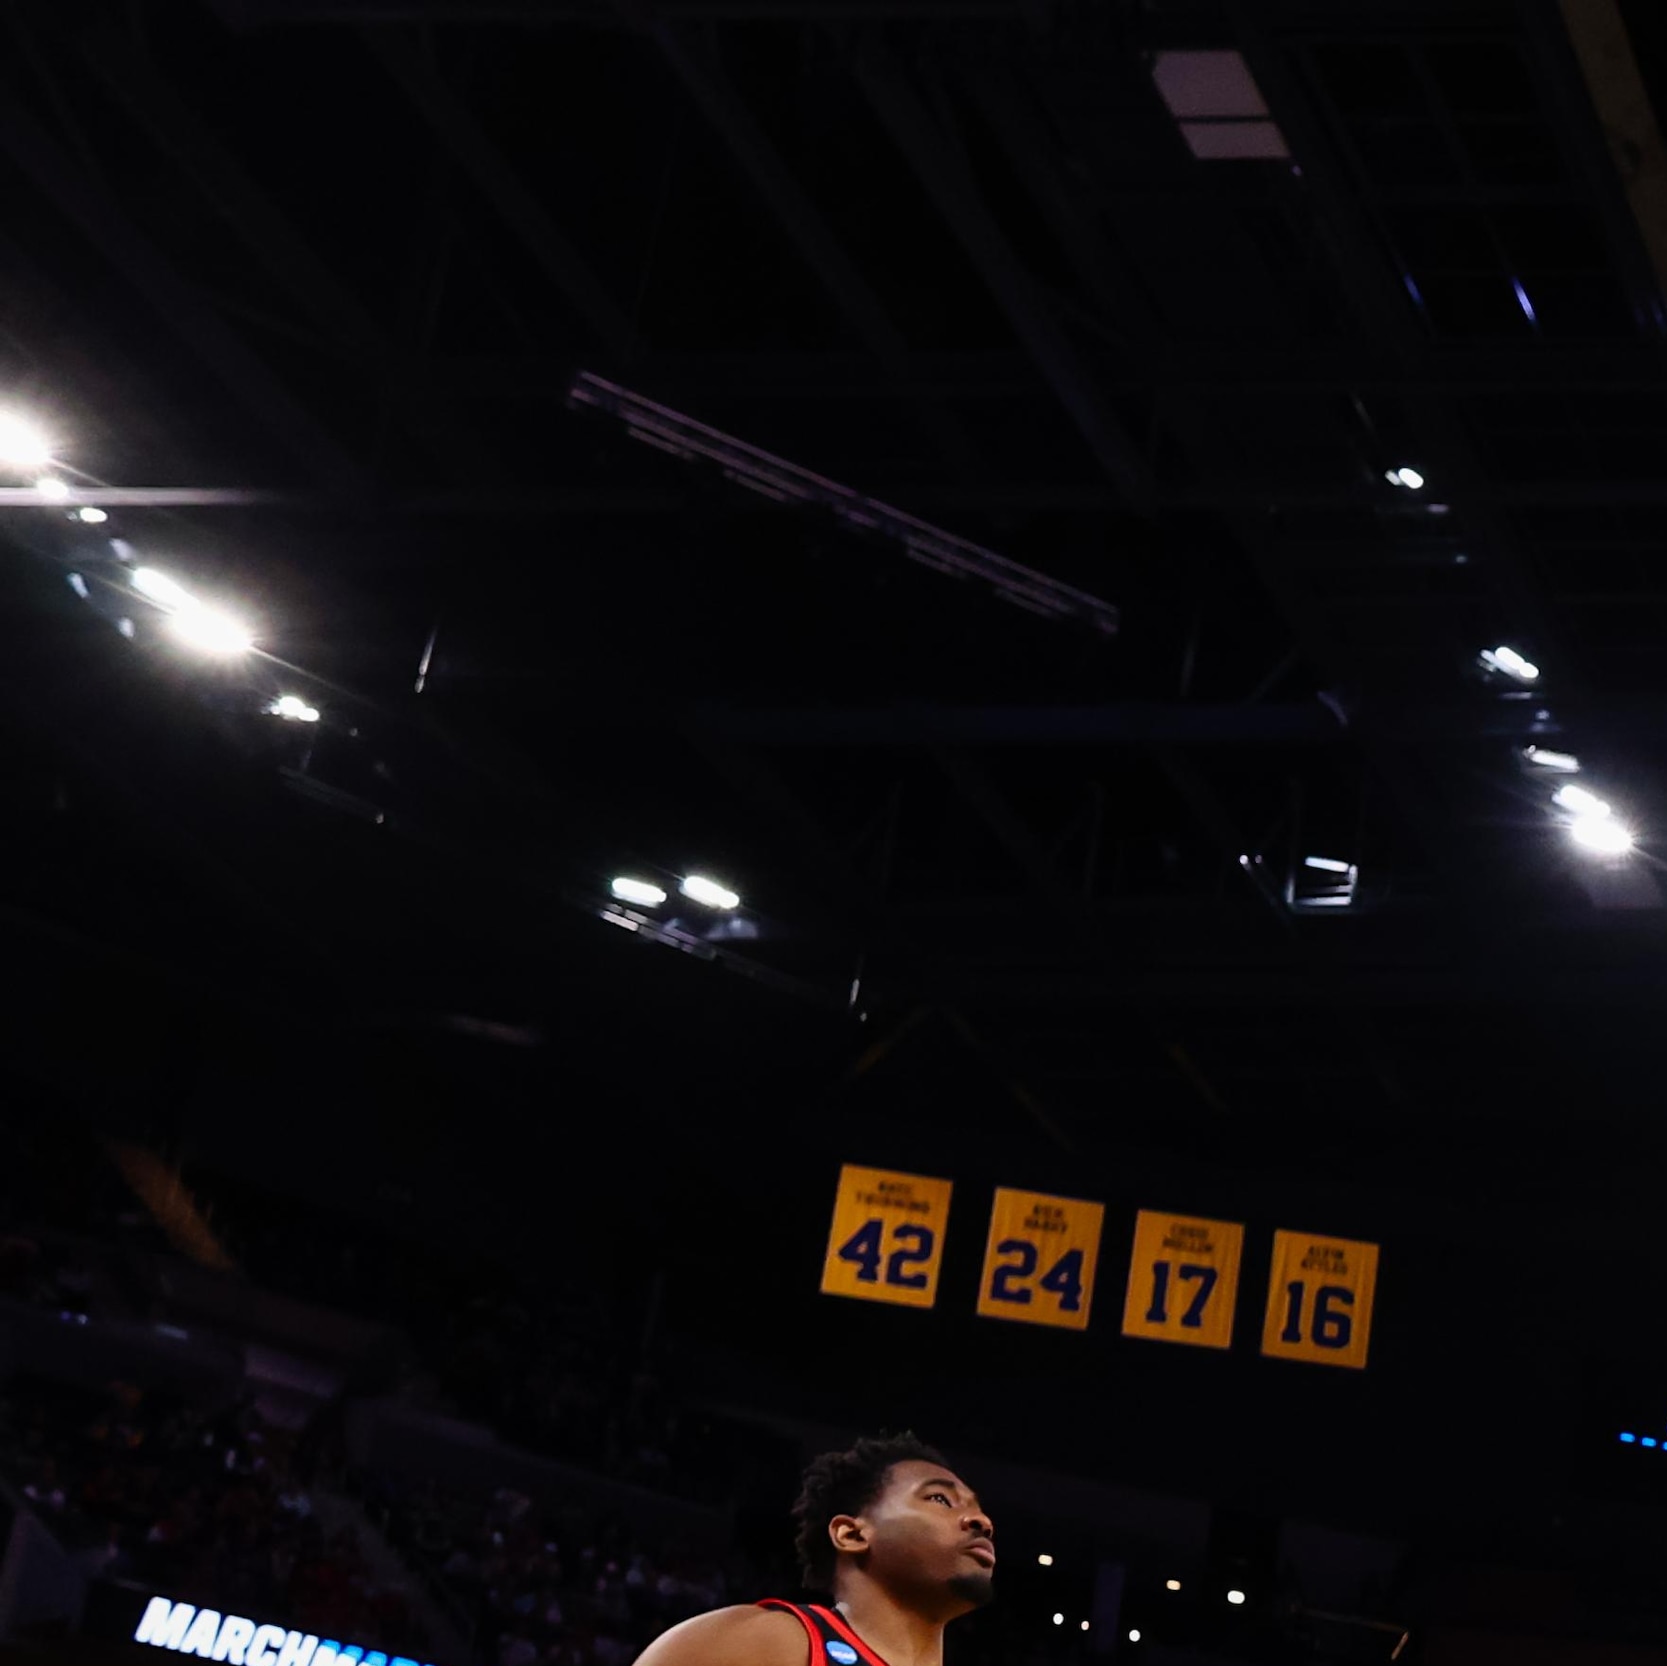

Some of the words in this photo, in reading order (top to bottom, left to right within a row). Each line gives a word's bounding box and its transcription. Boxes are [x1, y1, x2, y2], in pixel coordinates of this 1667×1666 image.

[838, 1218, 935, 1290] 42
[990, 1239, 1085, 1313] 24
[1145, 1261, 1218, 1328] 17
[1281, 1281, 1357, 1350] 16
